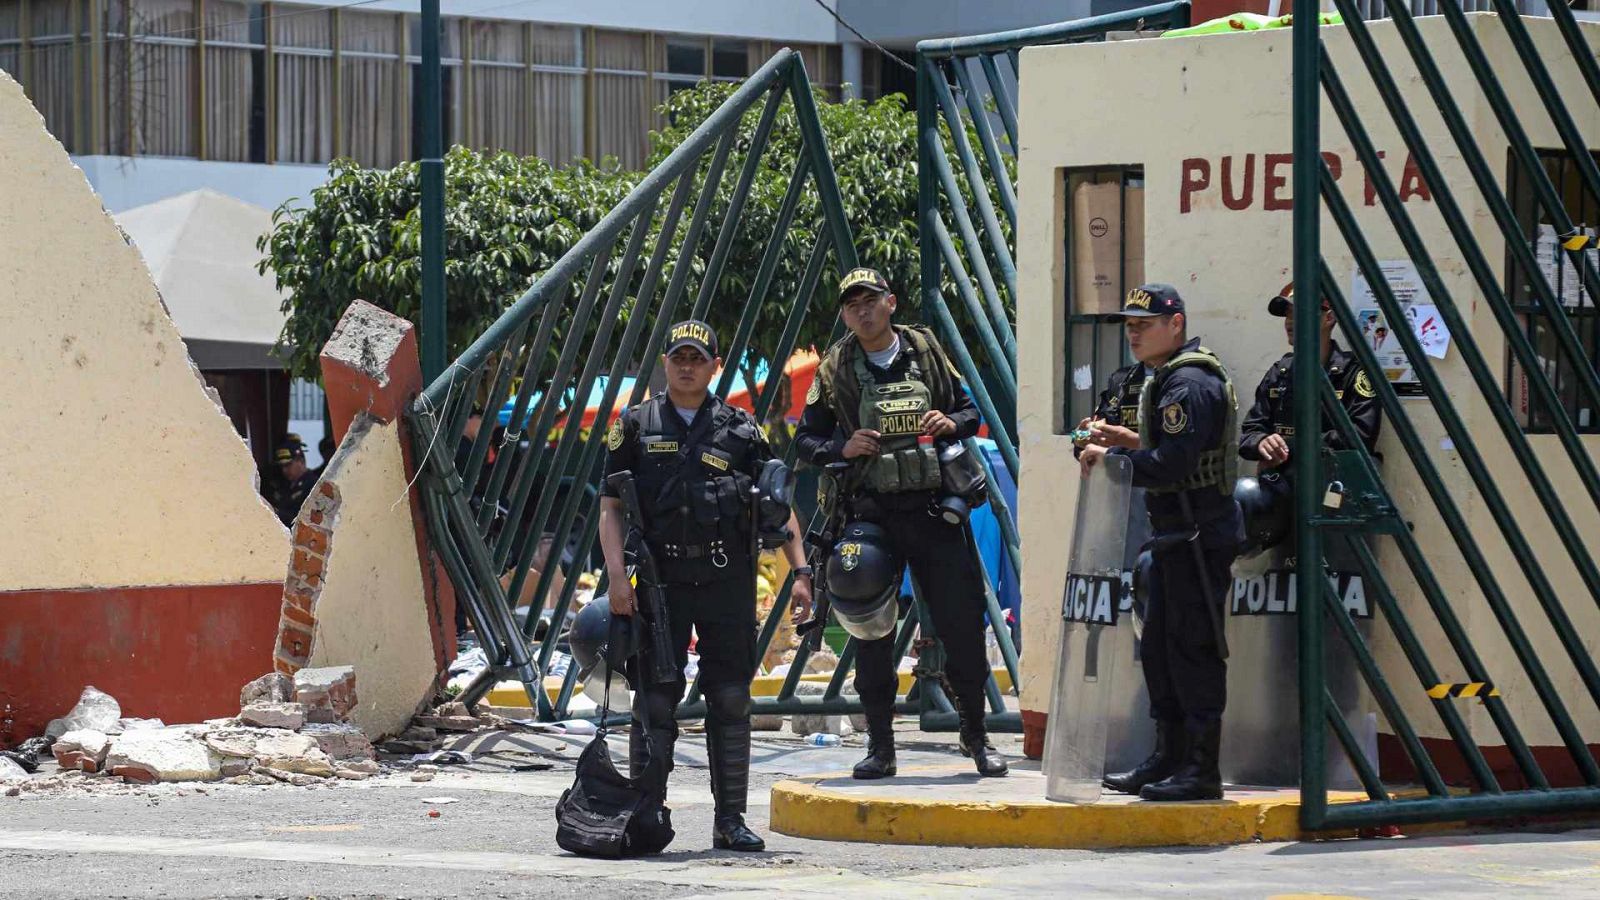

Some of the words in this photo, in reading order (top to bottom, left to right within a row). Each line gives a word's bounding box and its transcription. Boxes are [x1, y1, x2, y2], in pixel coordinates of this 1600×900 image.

[839, 269, 878, 294] POLICIA
[671, 323, 709, 346] POLICIA
[1122, 408, 1138, 428] POL
[1232, 572, 1369, 617] POLIA
